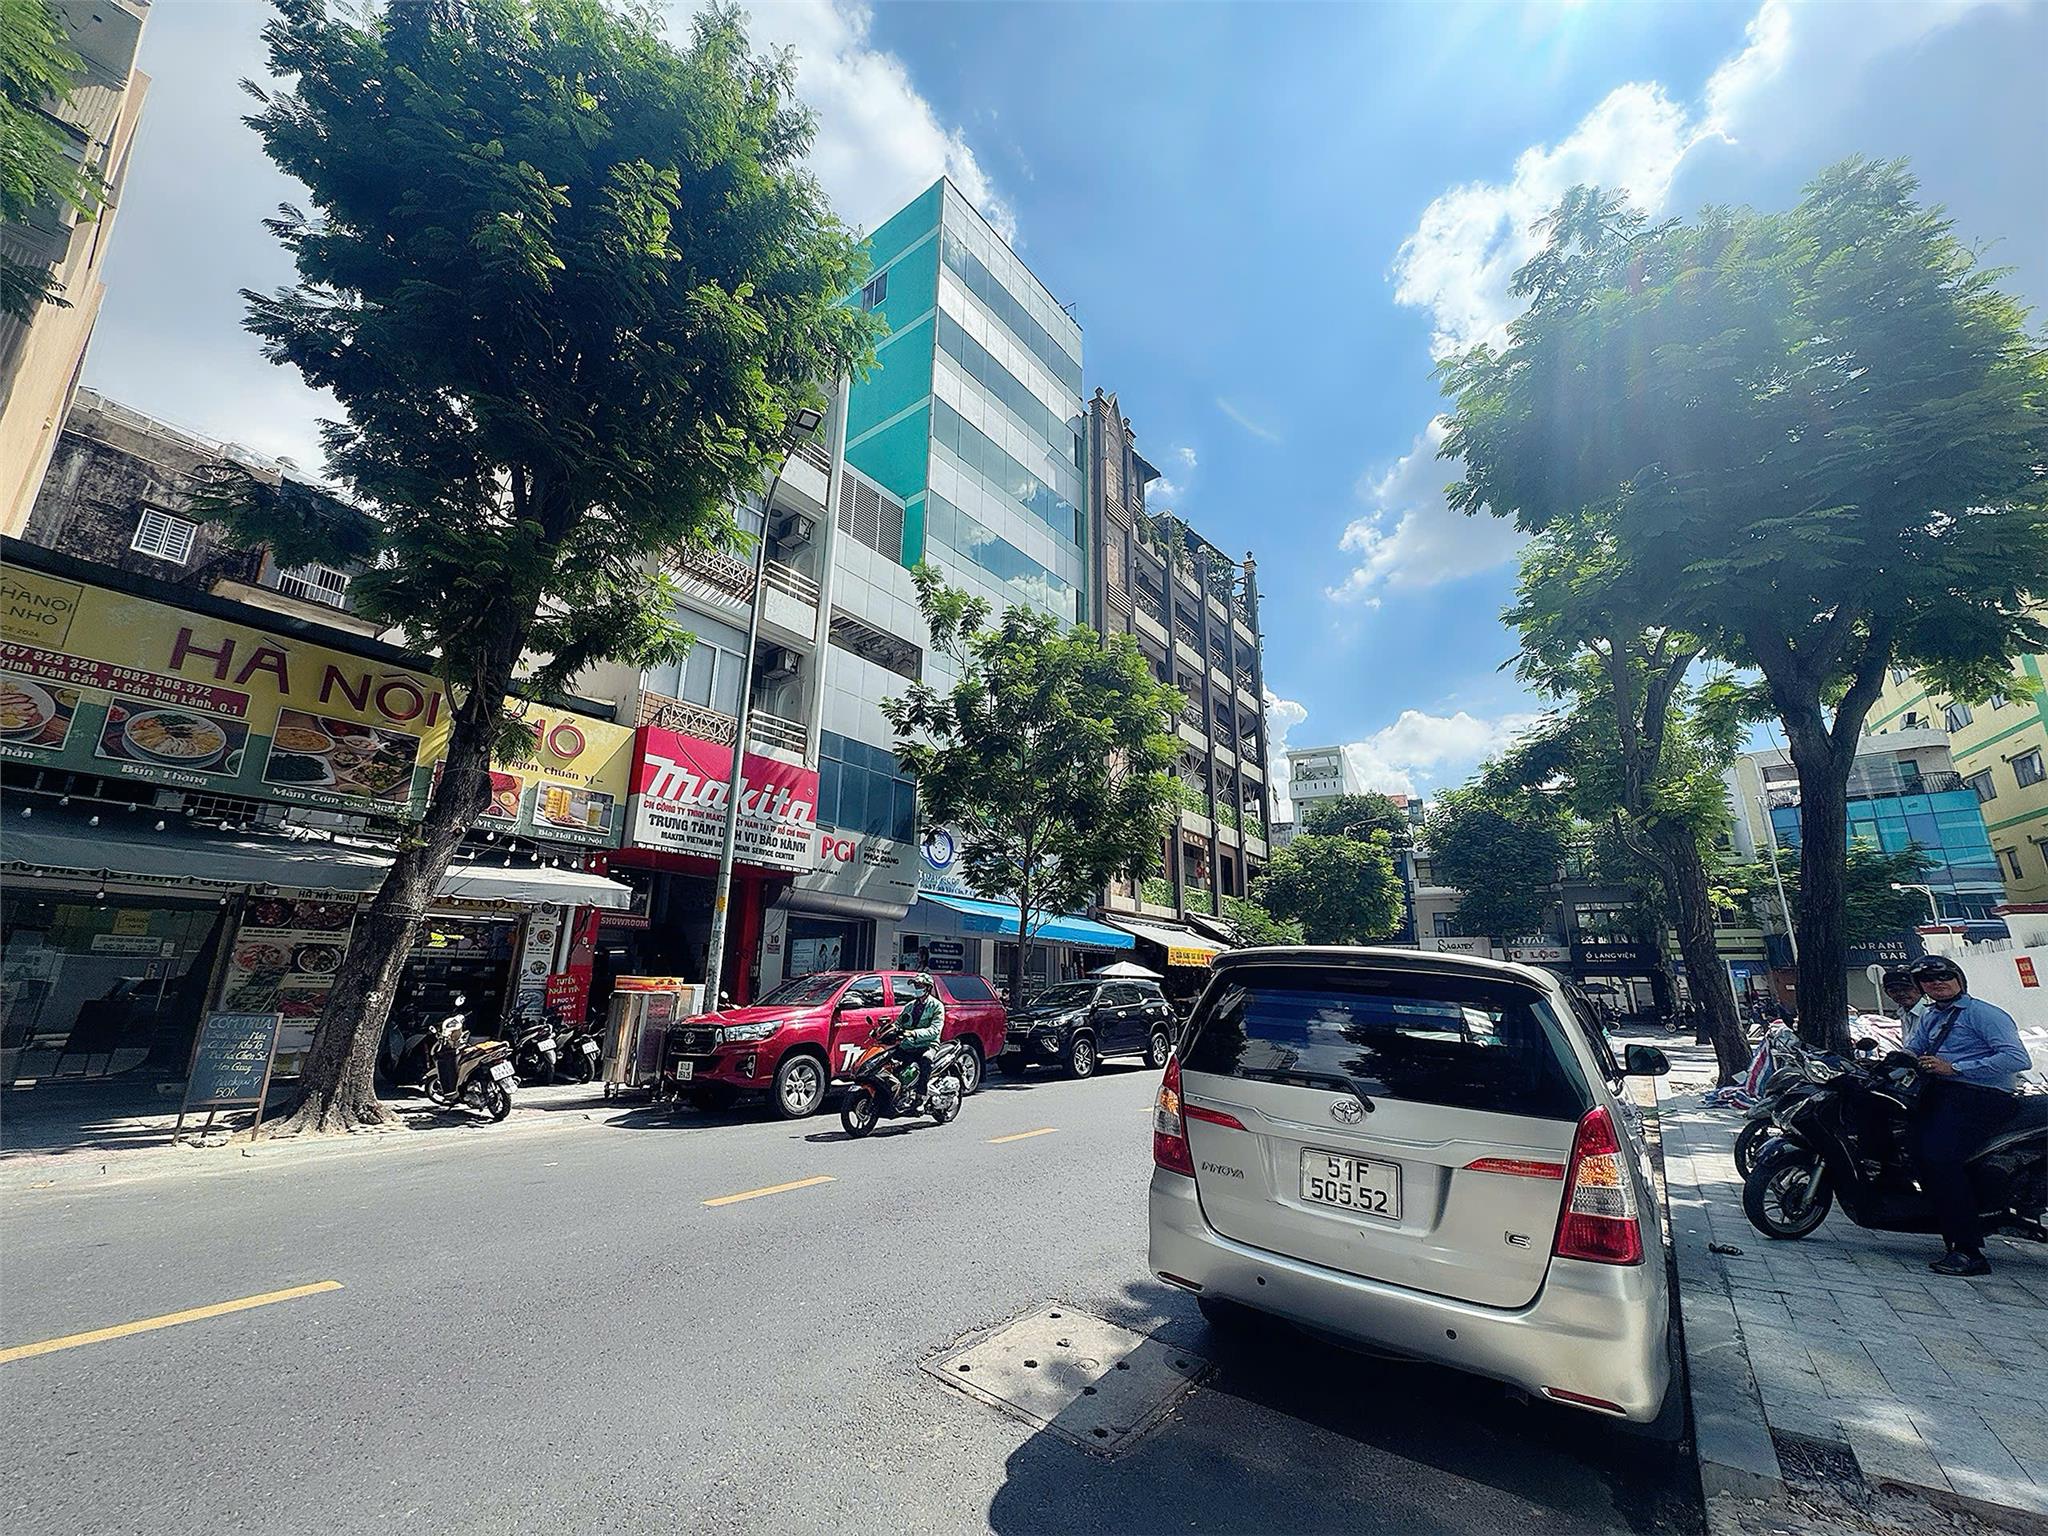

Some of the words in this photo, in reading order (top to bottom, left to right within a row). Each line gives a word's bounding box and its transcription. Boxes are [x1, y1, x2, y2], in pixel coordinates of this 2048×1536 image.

[33, 651, 65, 665] 823
[69, 659, 99, 673] 320
[112, 667, 212, 697] 0982.508.372
[169, 627, 290, 695] HÀ
[319, 665, 441, 727] NỘI
[648, 814, 689, 832] TRUNG
[691, 821, 717, 837] TÂM
[717, 826, 743, 841] DH
[744, 831, 758, 846] VỤ
[759, 833, 778, 848] BẢO
[779, 838, 807, 853] HÀNH
[600, 916, 649, 928] SHOWROOM
[1848, 941, 1905, 951] AURANT
[1879, 951, 1908, 961] BAR
[1201, 1161, 1245, 1180] INNOVA
[1328, 1156, 1369, 1183] 51F
[1311, 1177, 1389, 1214] 505.52
